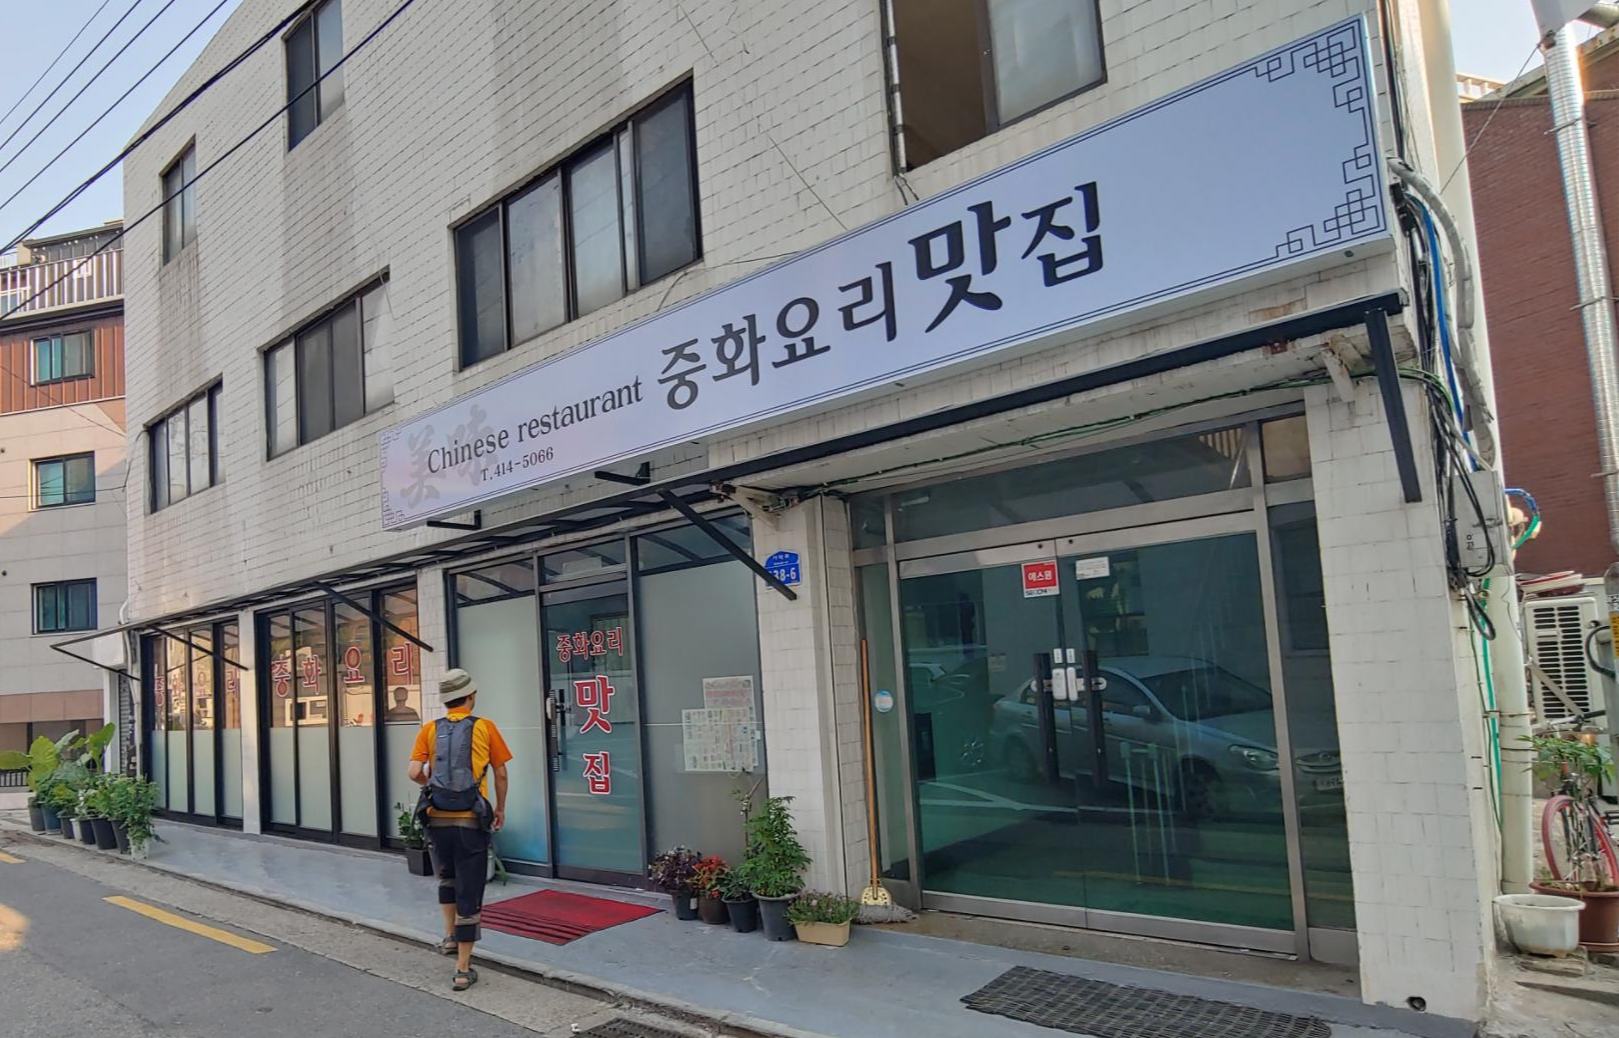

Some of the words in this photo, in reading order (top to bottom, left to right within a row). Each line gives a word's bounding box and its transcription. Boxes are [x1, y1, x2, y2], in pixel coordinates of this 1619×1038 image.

[427, 428, 509, 474] Chinese
[517, 377, 644, 443] restaurant
[480, 446, 554, 482] T.414-5066
[768, 567, 796, 582] 38-6
[556, 627, 623, 663] 중화요리
